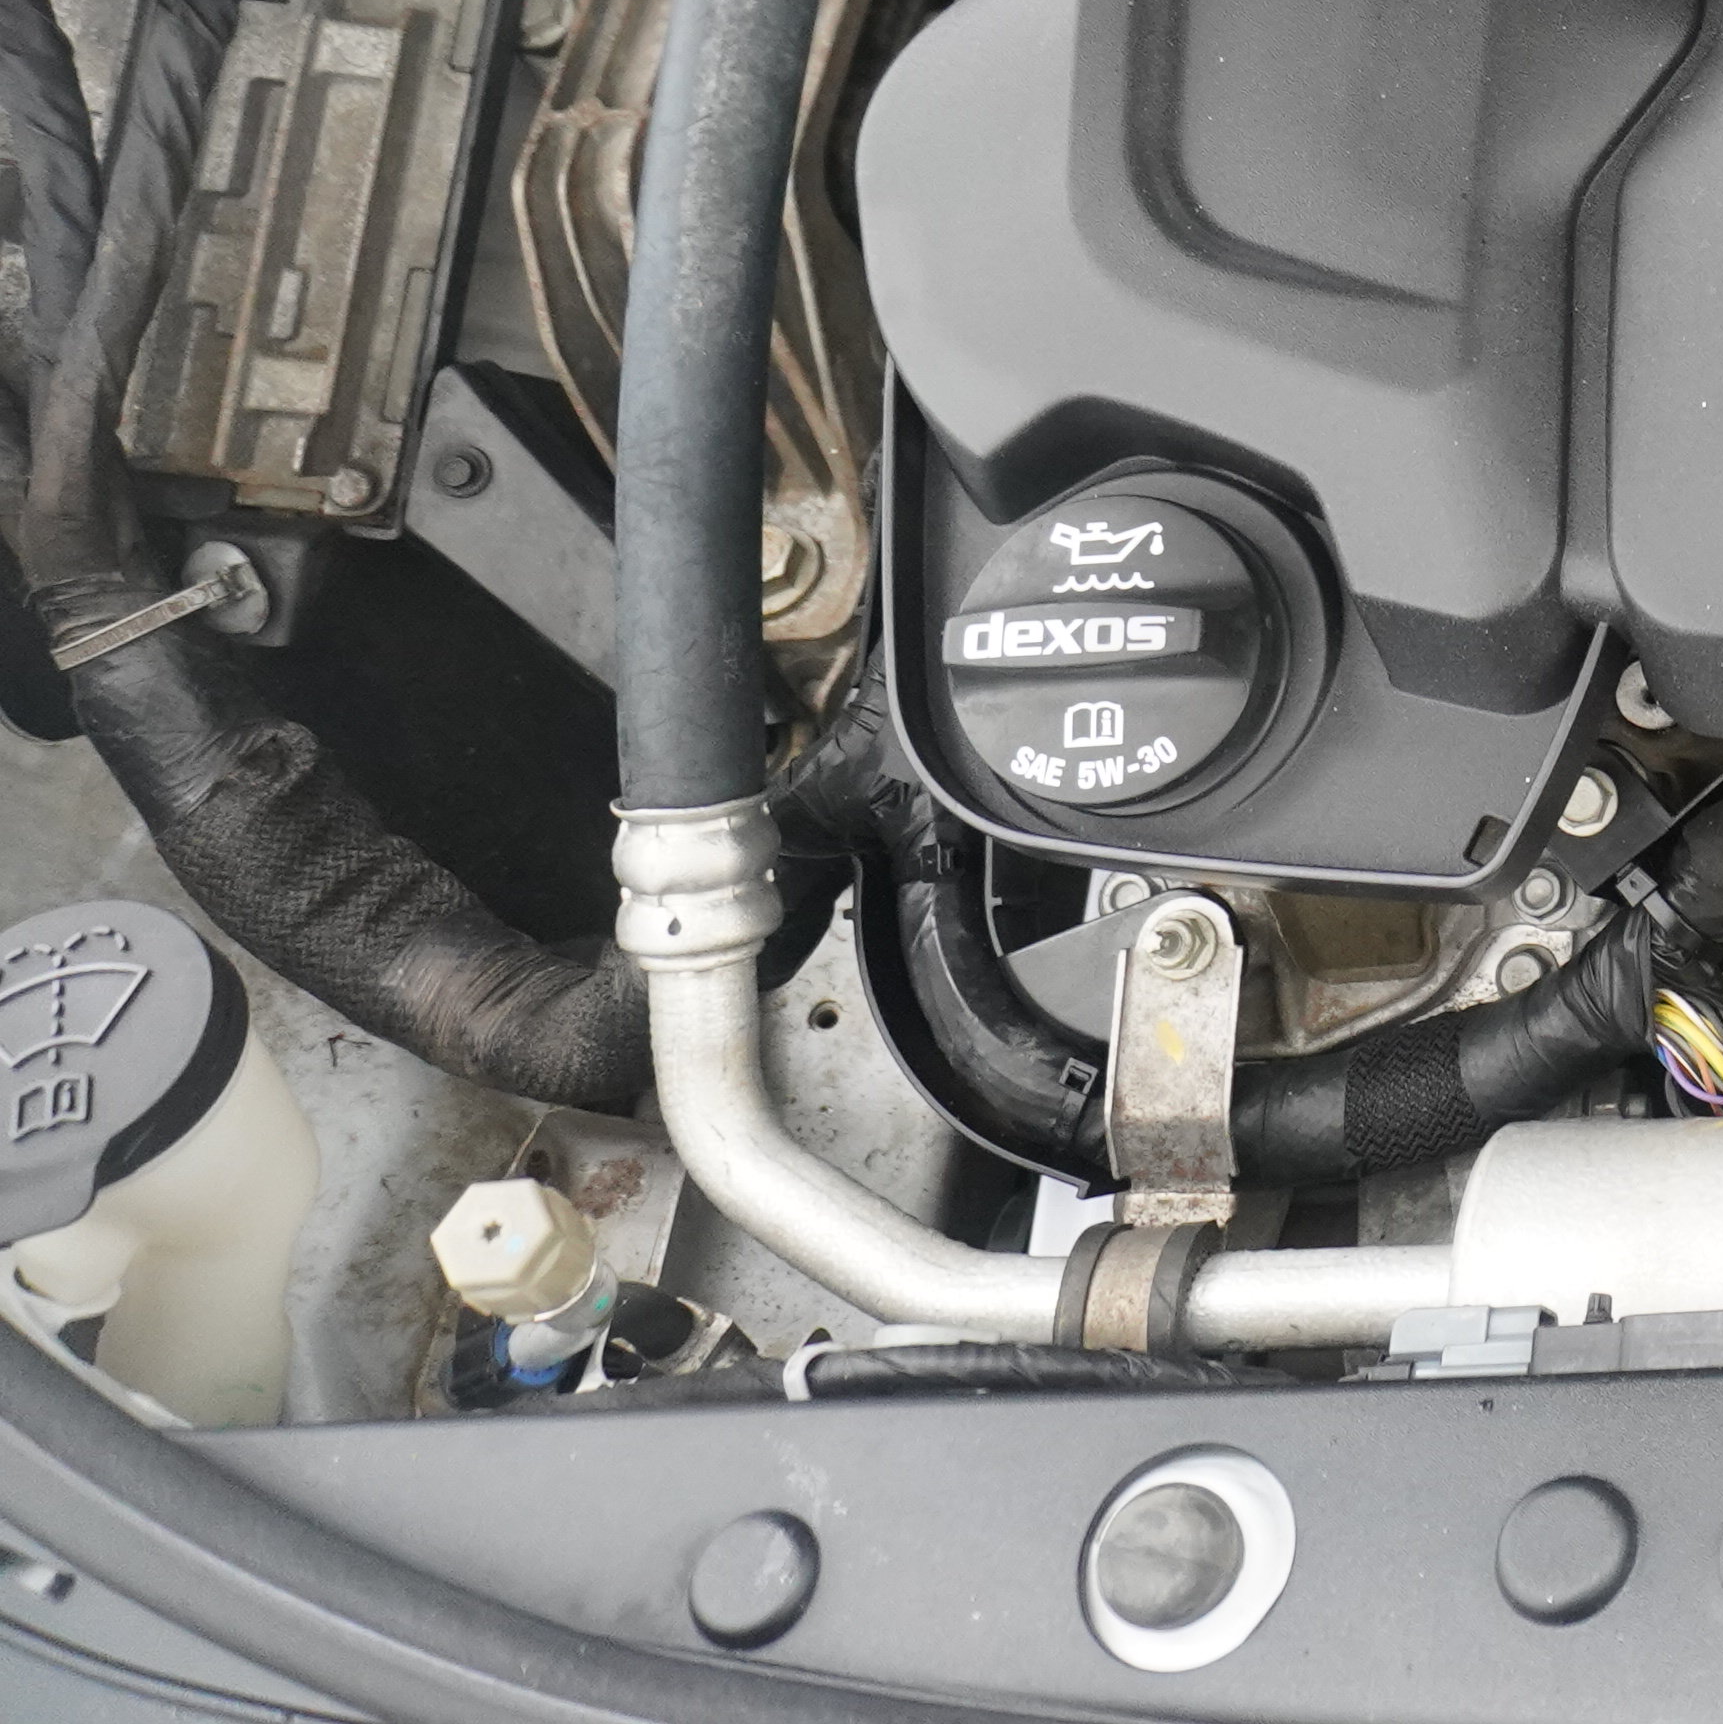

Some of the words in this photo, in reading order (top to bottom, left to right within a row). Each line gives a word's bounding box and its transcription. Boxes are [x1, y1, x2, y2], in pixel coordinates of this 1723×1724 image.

[962, 613, 1169, 661] dexos
[1009, 744, 1067, 790] SAE
[1076, 734, 1179, 791] 5W-30
